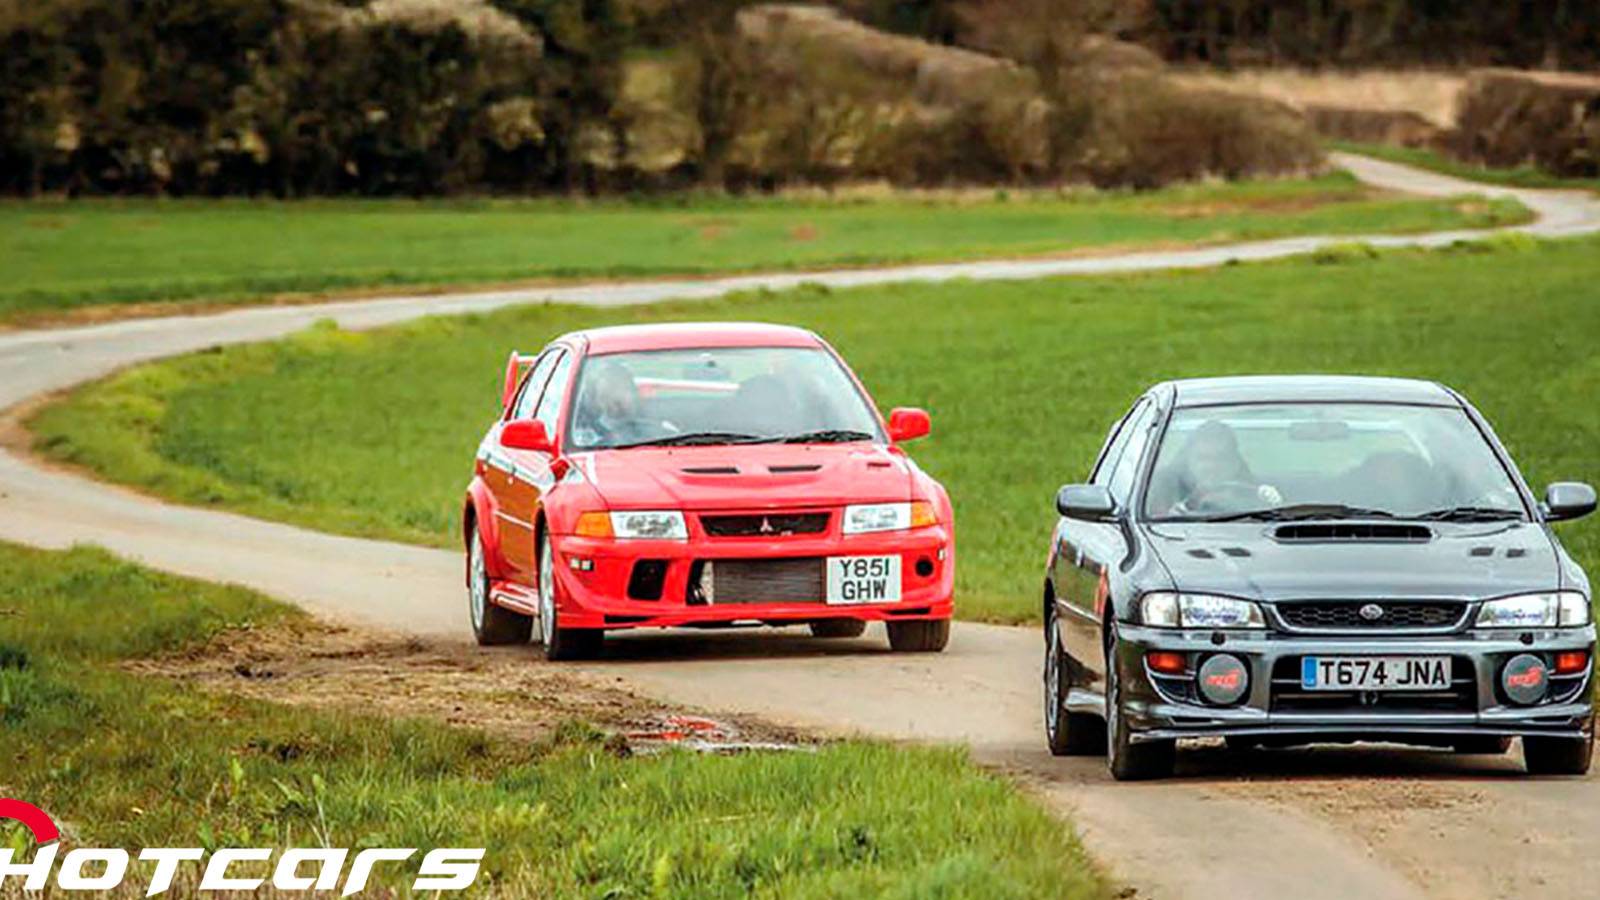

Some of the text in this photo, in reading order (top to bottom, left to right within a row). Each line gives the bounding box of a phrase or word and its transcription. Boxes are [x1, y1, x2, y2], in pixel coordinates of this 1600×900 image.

[840, 558, 890, 577] Y851
[841, 579, 886, 600] GHW
[1320, 660, 1446, 686] T674 JNA
